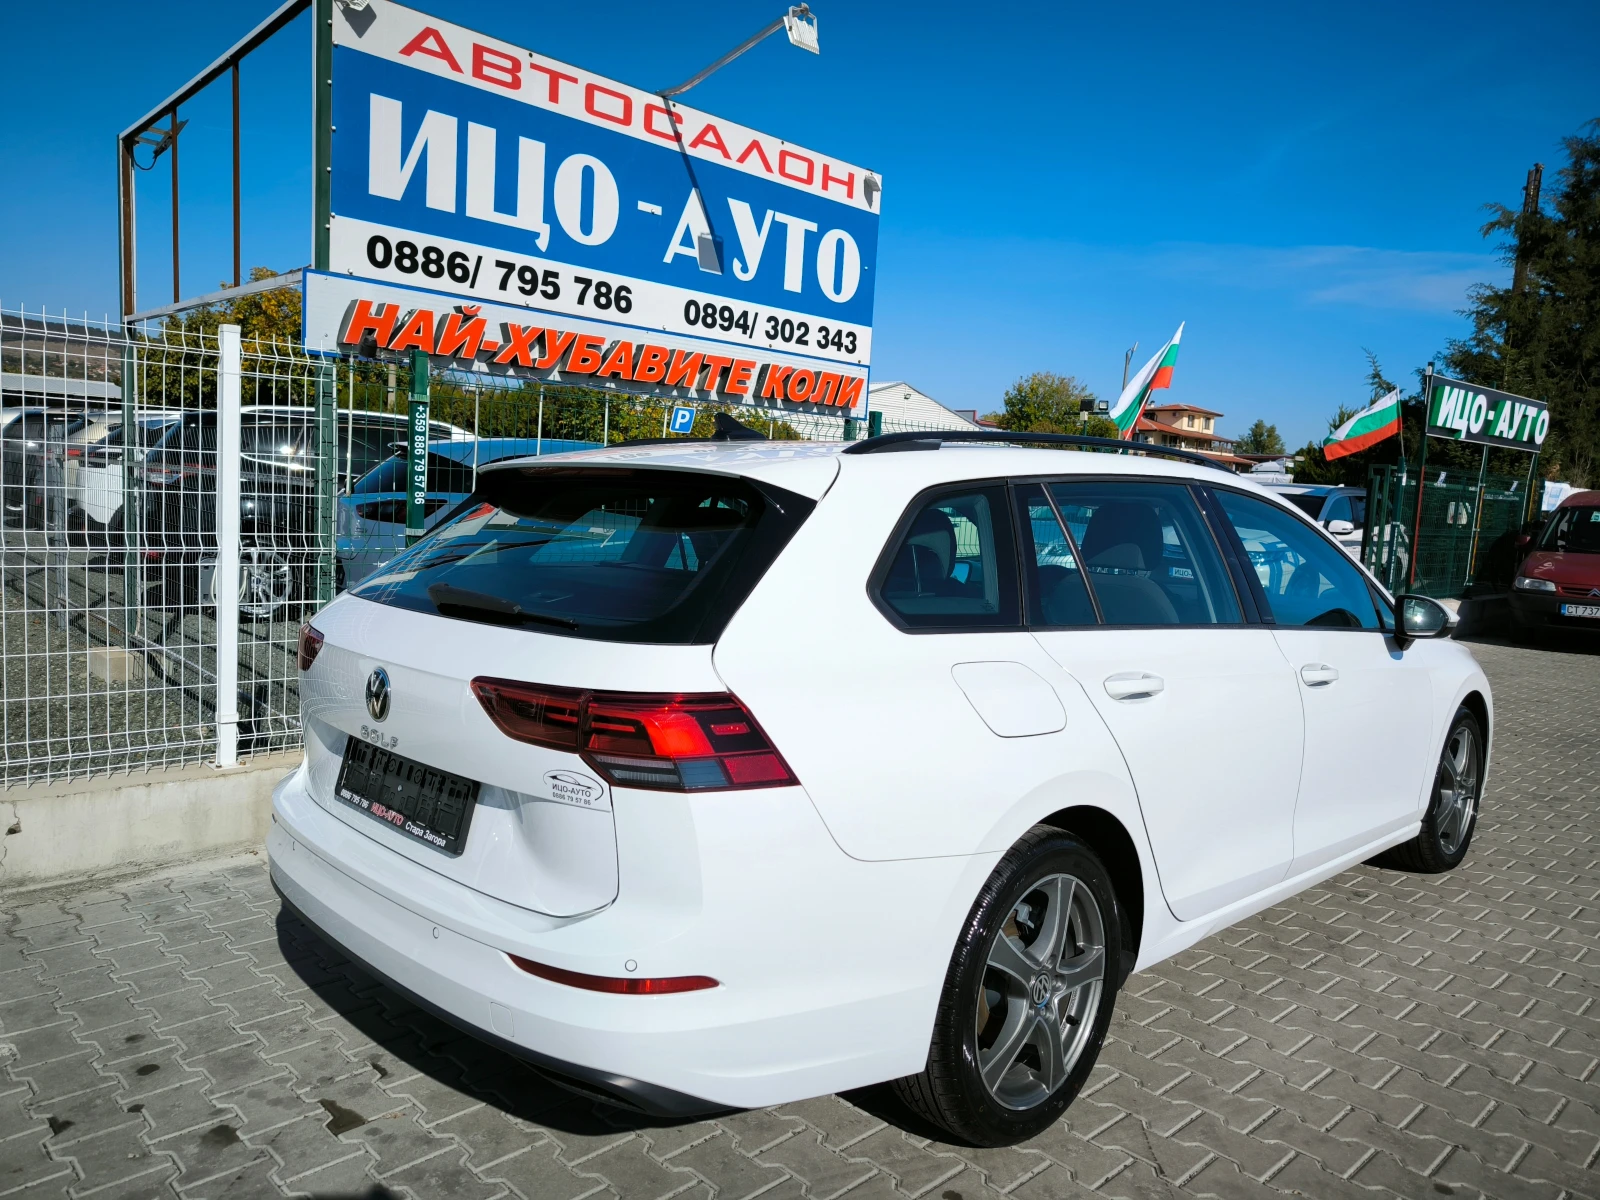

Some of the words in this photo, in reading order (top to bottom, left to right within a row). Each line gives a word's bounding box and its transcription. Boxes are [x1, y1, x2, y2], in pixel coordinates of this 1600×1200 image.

[399, 26, 855, 199] АВТОСАЛОН
[366, 235, 483, 289] 0886/
[494, 259, 561, 301] 795
[573, 275, 633, 314] 786
[683, 299, 759, 339] 0894/
[765, 315, 810, 346] 302
[816, 325, 858, 354] 343
[343, 298, 757, 395] НАЙ-ХУБАВИТЕ
[761, 363, 865, 409] КОЛИ
[415, 405, 426, 432] +359
[1436, 385, 1550, 445] ИЦО-АУТО
[414, 435, 425, 455] 886
[414, 458, 425, 472] 79
[414, 475, 425, 488] 57
[414, 492, 425, 505] 86
[552, 783, 591, 797] ИЦО-АУТО
[405, 822, 423, 837] Стара
[423, 830, 446, 847] Загора
